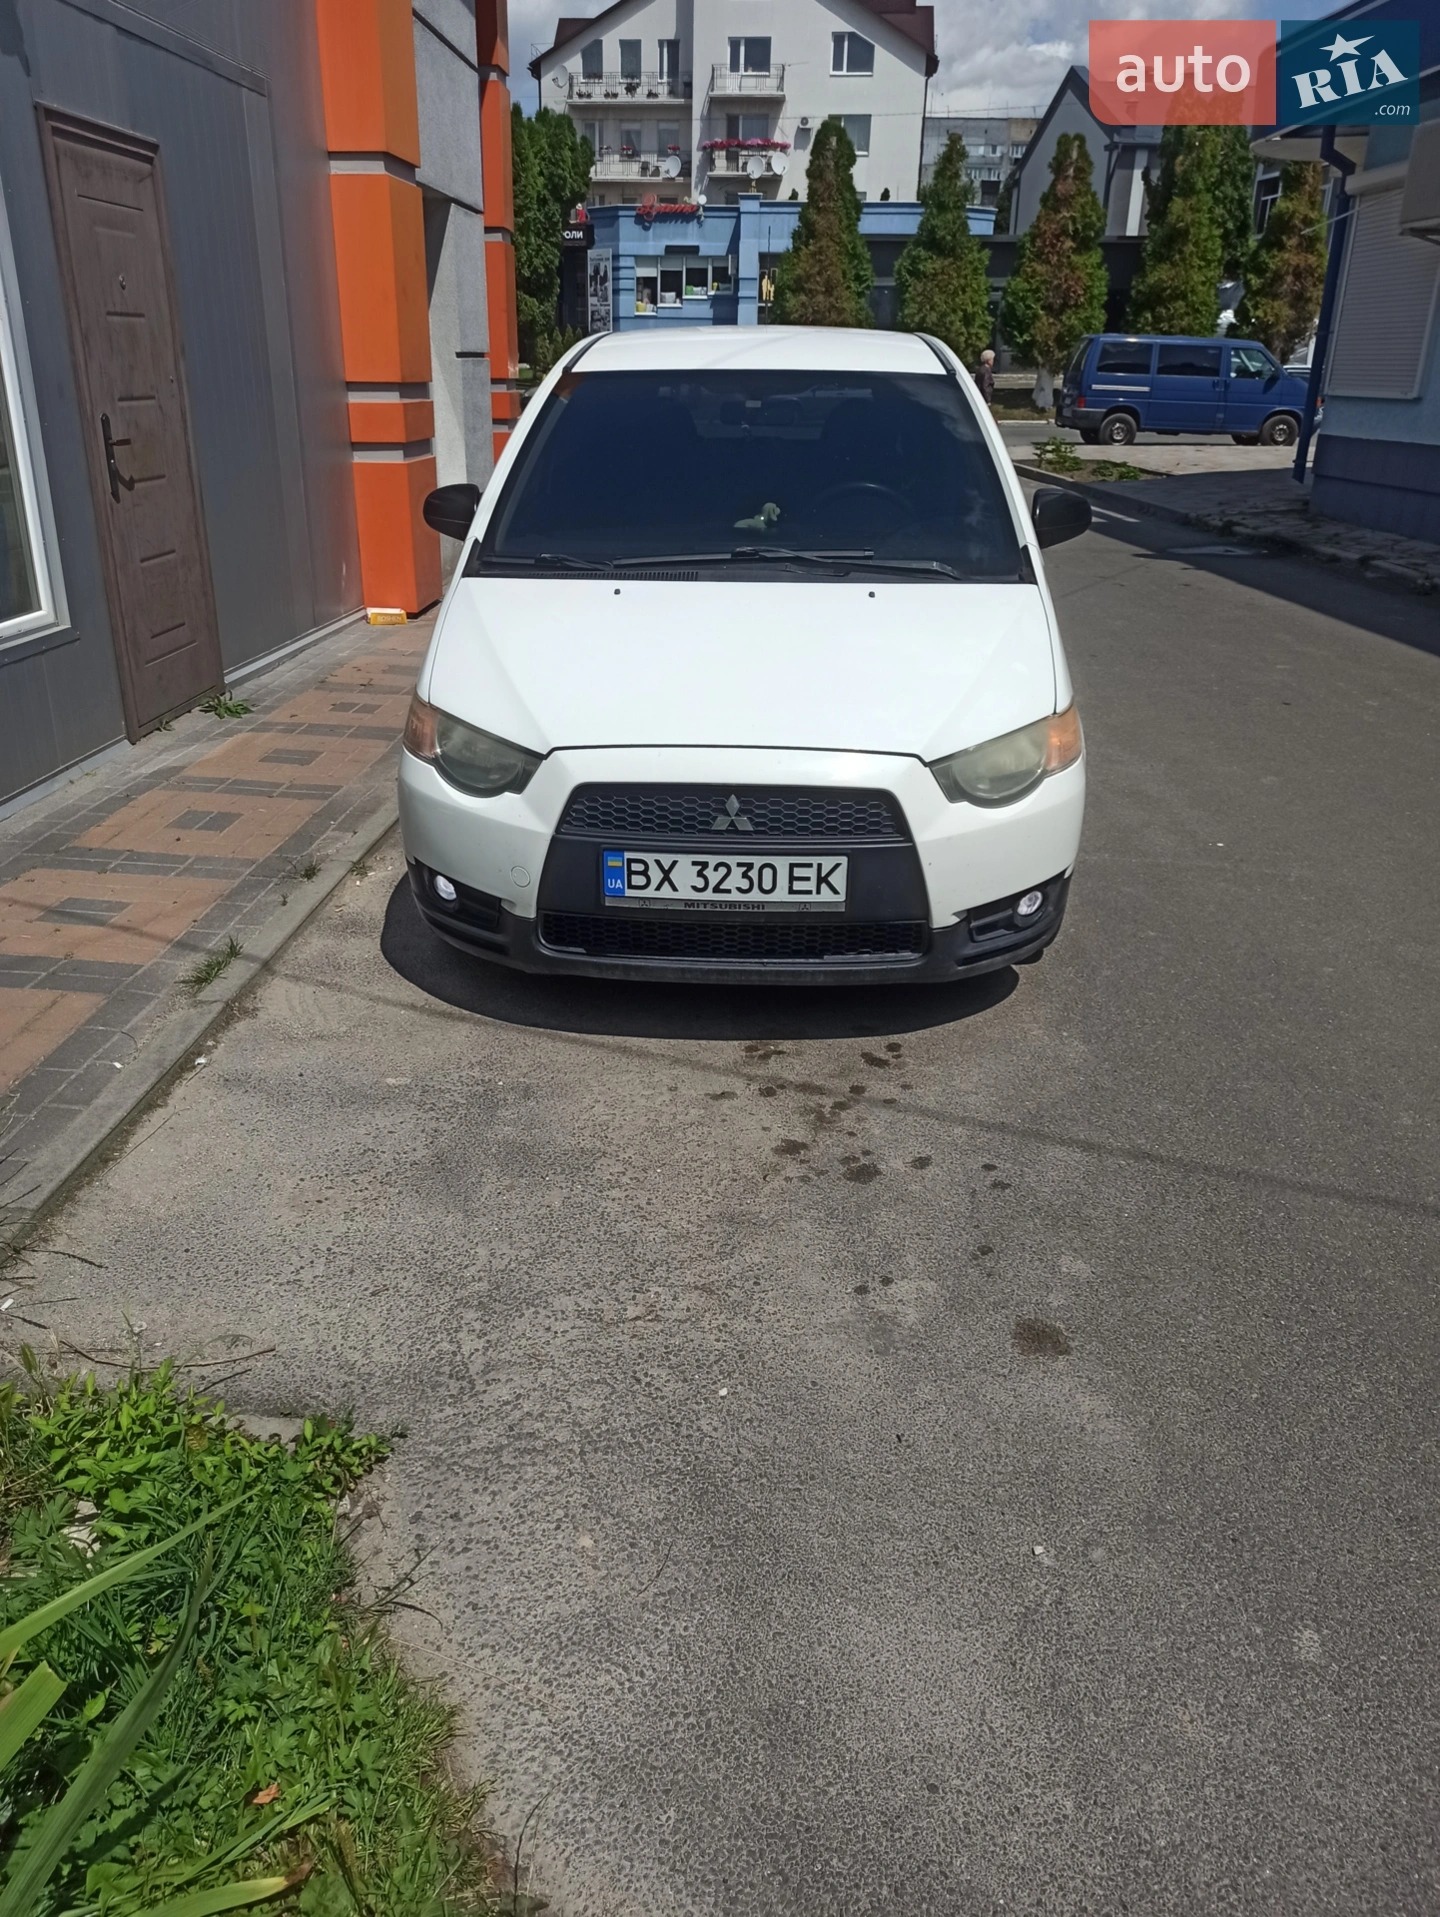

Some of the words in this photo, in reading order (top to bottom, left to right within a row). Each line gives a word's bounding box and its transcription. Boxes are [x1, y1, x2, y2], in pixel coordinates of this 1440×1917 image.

[563, 231, 583, 239] ОЛИ
[626, 857, 679, 892] BX
[690, 860, 778, 895] 3230
[788, 862, 843, 895] EK
[607, 878, 623, 889] UA
[684, 902, 765, 911] MITSUBISHI
